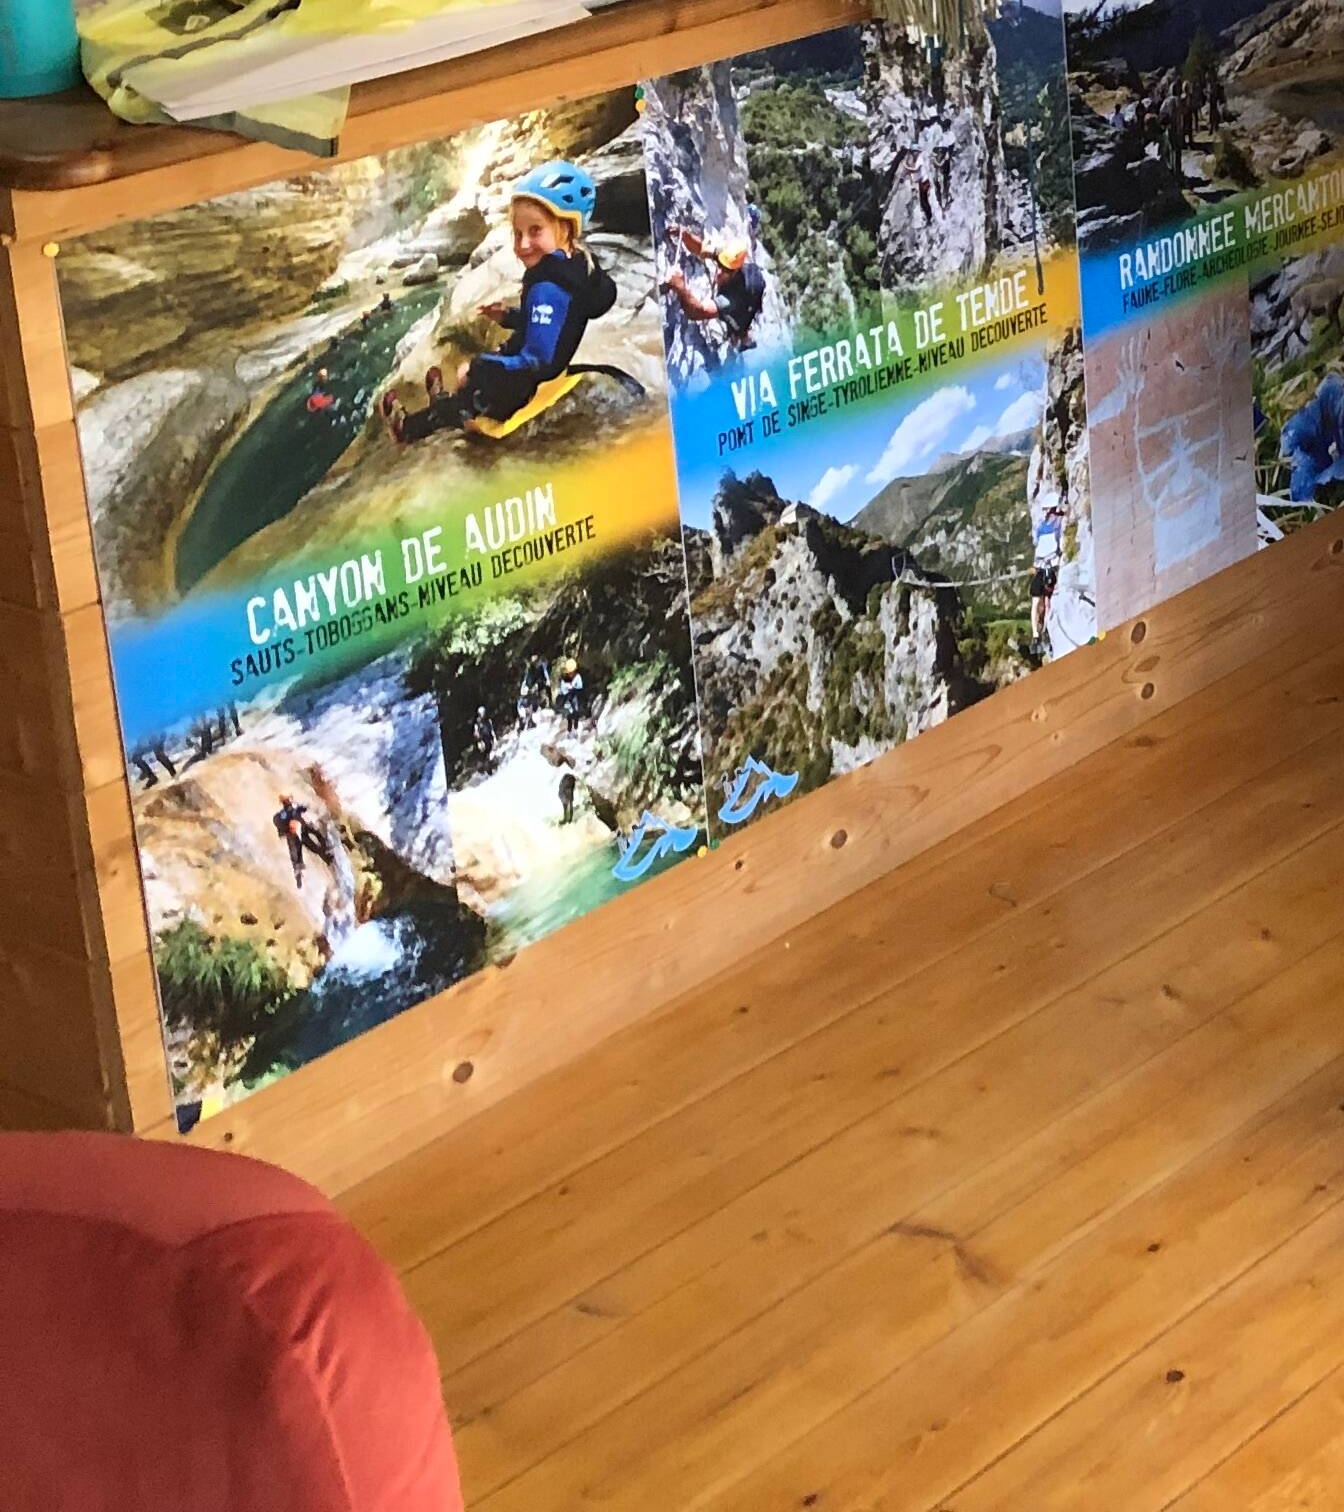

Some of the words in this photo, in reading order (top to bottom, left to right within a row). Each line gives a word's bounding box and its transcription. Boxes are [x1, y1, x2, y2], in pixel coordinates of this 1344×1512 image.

[1119, 212, 1236, 290] RANDONNEE
[718, 420, 755, 456] PONT
[762, 410, 781, 438] DE
[971, 303, 1048, 352] DECOUVERTE
[731, 370, 777, 421] VIA
[788, 321, 904, 399] FERRATA
[914, 302, 946, 348] DE
[956, 270, 1029, 331] TENDE
[247, 549, 386, 645] CANYON
[401, 526, 447, 585] DE
[464, 482, 557, 556] AUDIN
[490, 514, 596, 580] DECOUVERTE
